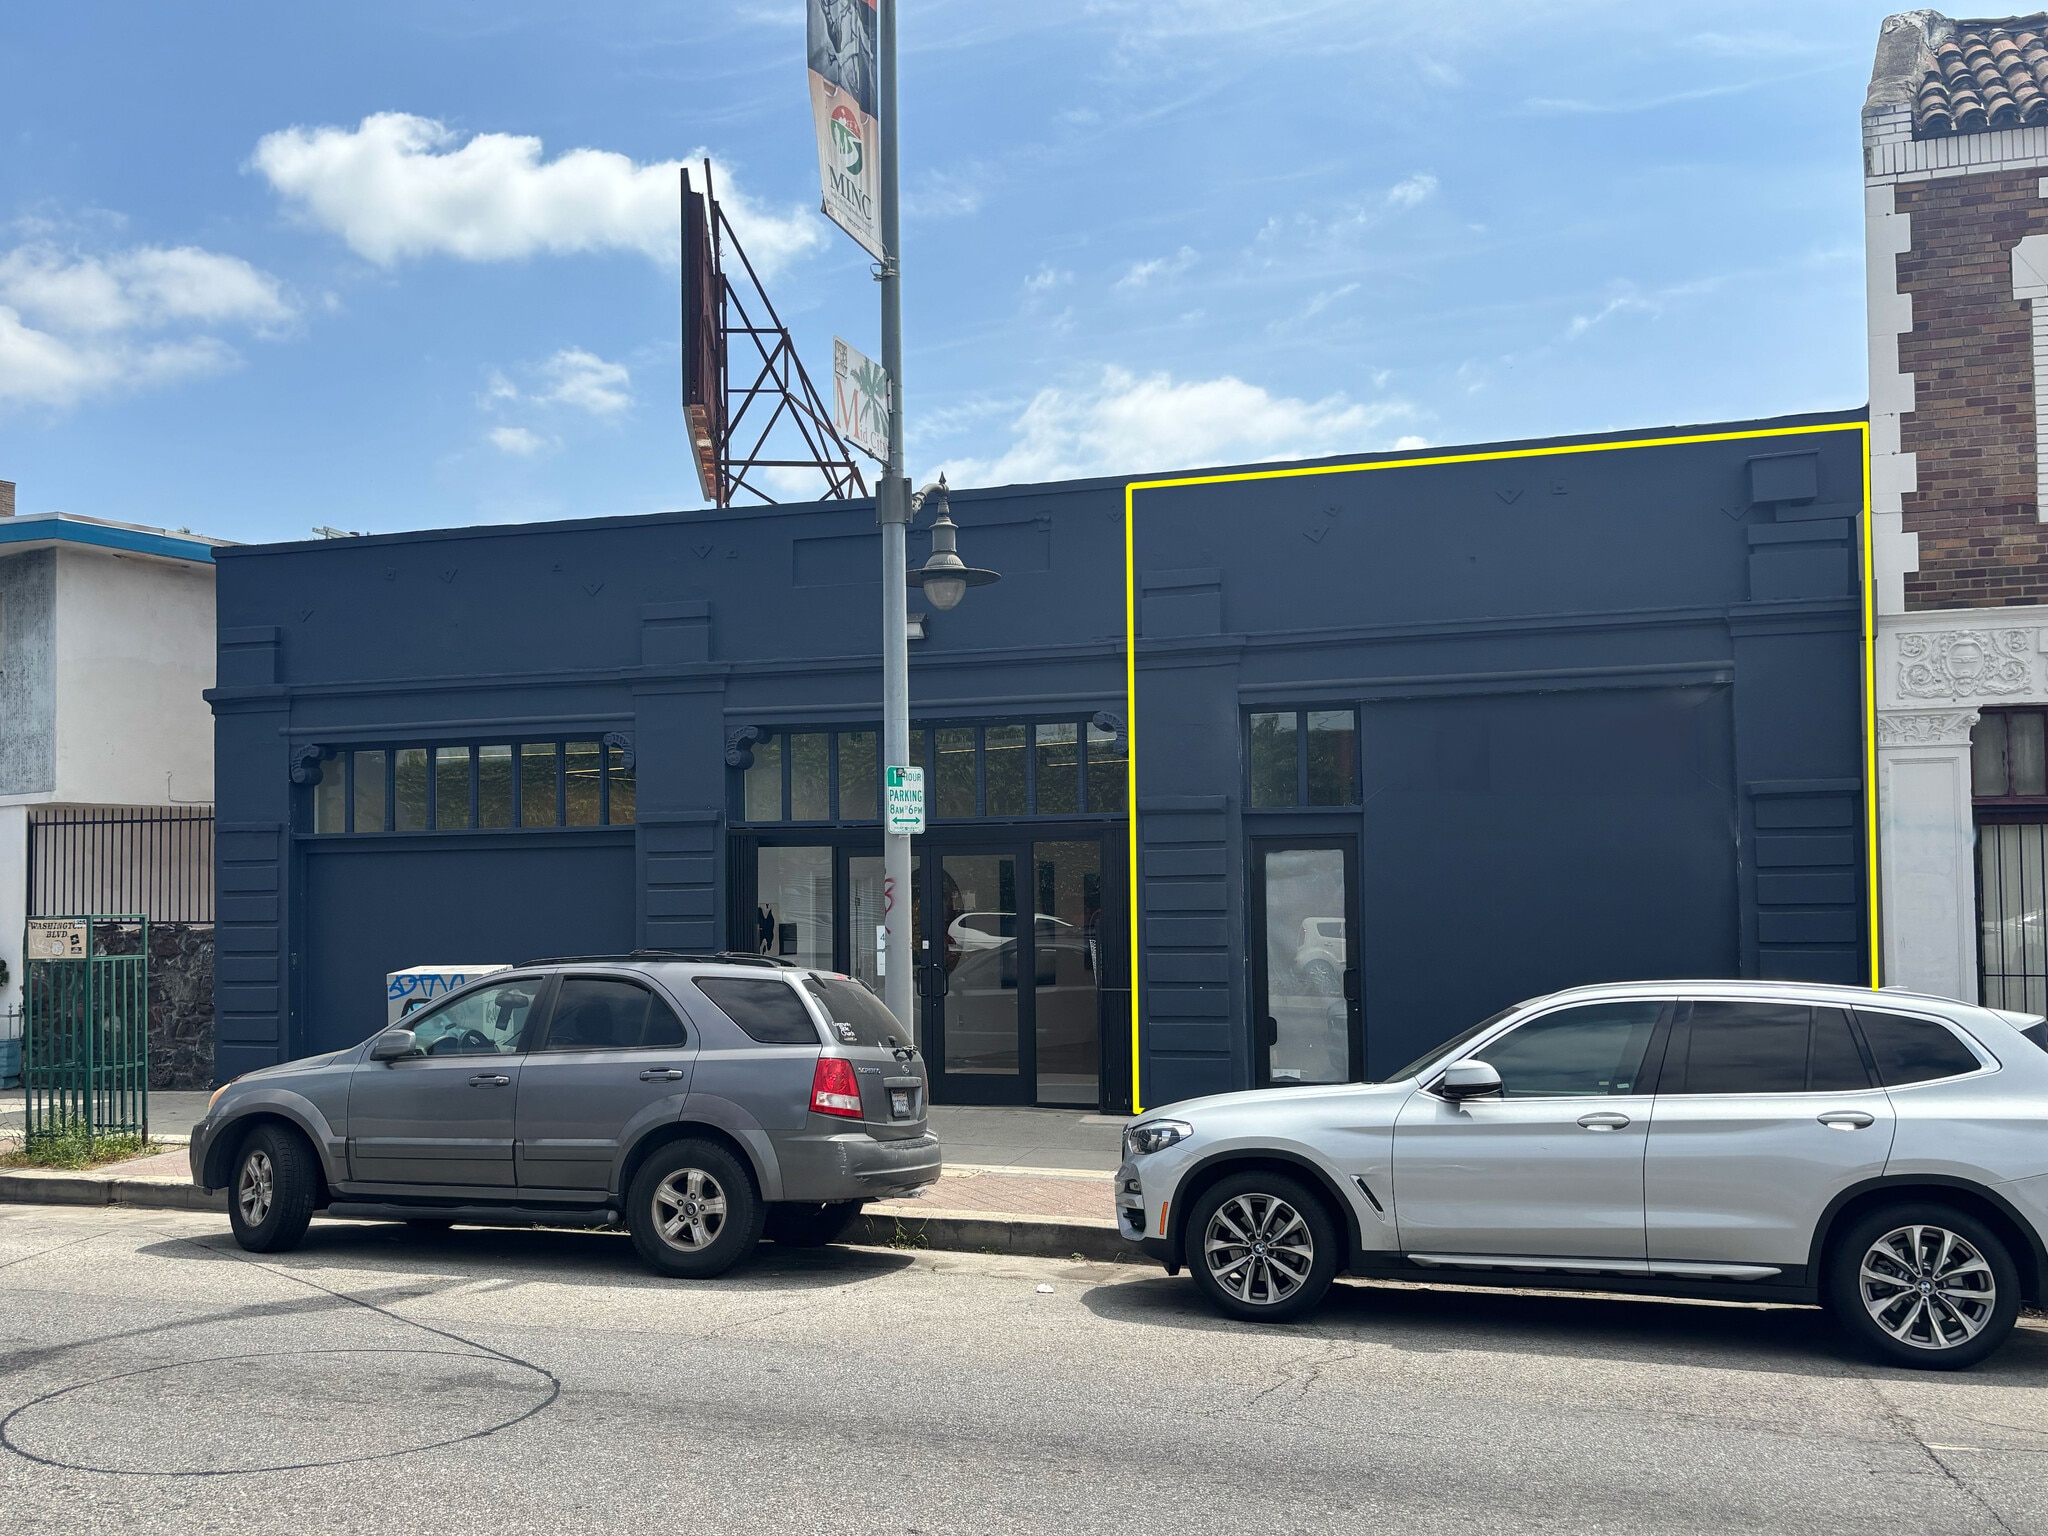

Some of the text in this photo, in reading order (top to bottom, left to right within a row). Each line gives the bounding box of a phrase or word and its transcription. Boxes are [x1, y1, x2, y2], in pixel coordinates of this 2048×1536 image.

[828, 163, 872, 220] MINC
[889, 789, 922, 802] PARKING
[889, 804, 923, 815] 8AM 6PM
[30, 921, 84, 930] WASHINGTO
[45, 930, 70, 938] BLVD.
